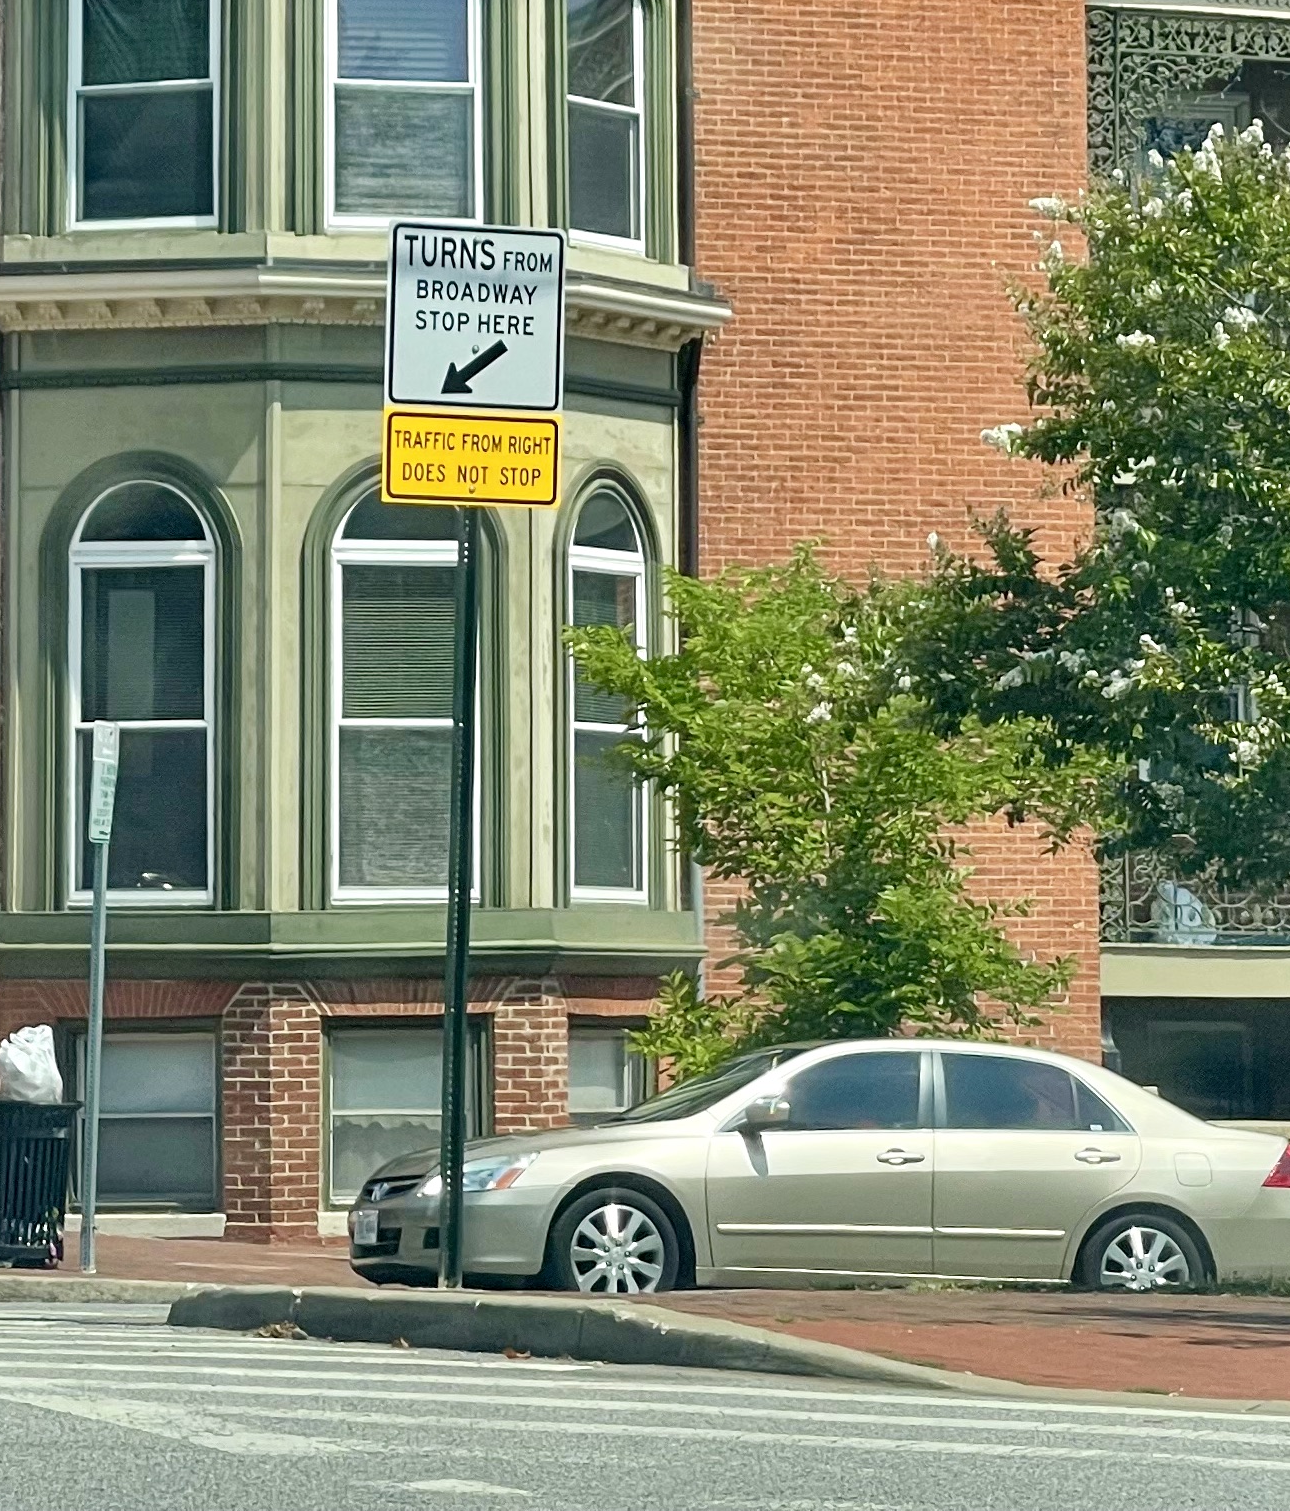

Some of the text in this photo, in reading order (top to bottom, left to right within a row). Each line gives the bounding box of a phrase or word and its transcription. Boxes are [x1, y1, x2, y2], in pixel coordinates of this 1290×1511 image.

[404, 235, 553, 273] TURNS FROM
[416, 279, 537, 305] BROADWAY
[415, 310, 535, 336] STOP HERE
[394, 429, 551, 456] TRAFFIC FROM RIGHT
[402, 462, 542, 487] DOES NOT STOP
